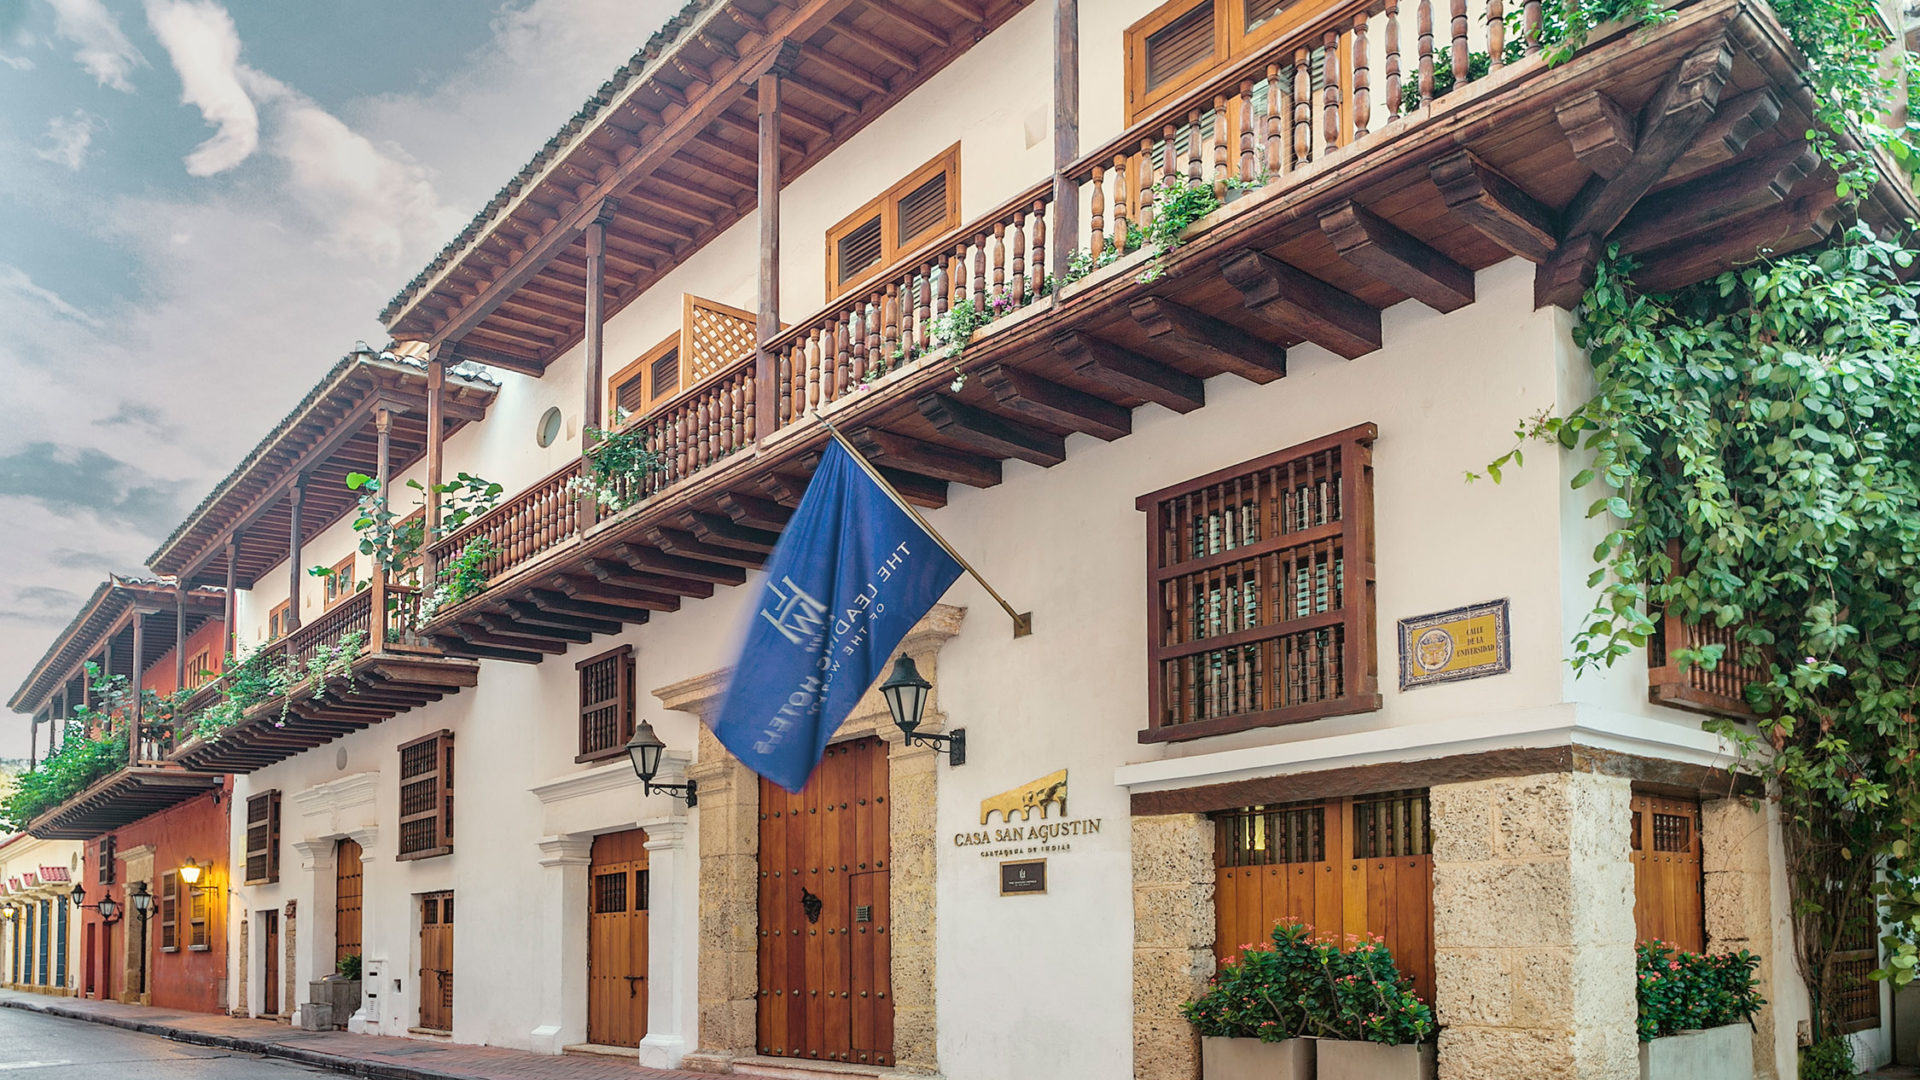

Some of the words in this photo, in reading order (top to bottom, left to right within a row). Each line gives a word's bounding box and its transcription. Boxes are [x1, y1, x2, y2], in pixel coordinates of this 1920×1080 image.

[1466, 626, 1483, 635] CALLE
[1467, 637, 1475, 645] DE
[1476, 636, 1484, 644] LA
[1457, 644, 1495, 656] UNIVERSIDAD
[954, 831, 991, 847] CASA
[995, 827, 1024, 842] SAN
[1028, 818, 1102, 843] AGUSTIN
[980, 848, 1024, 857] CARTAGENA
[1041, 844, 1071, 852] INDIAS
